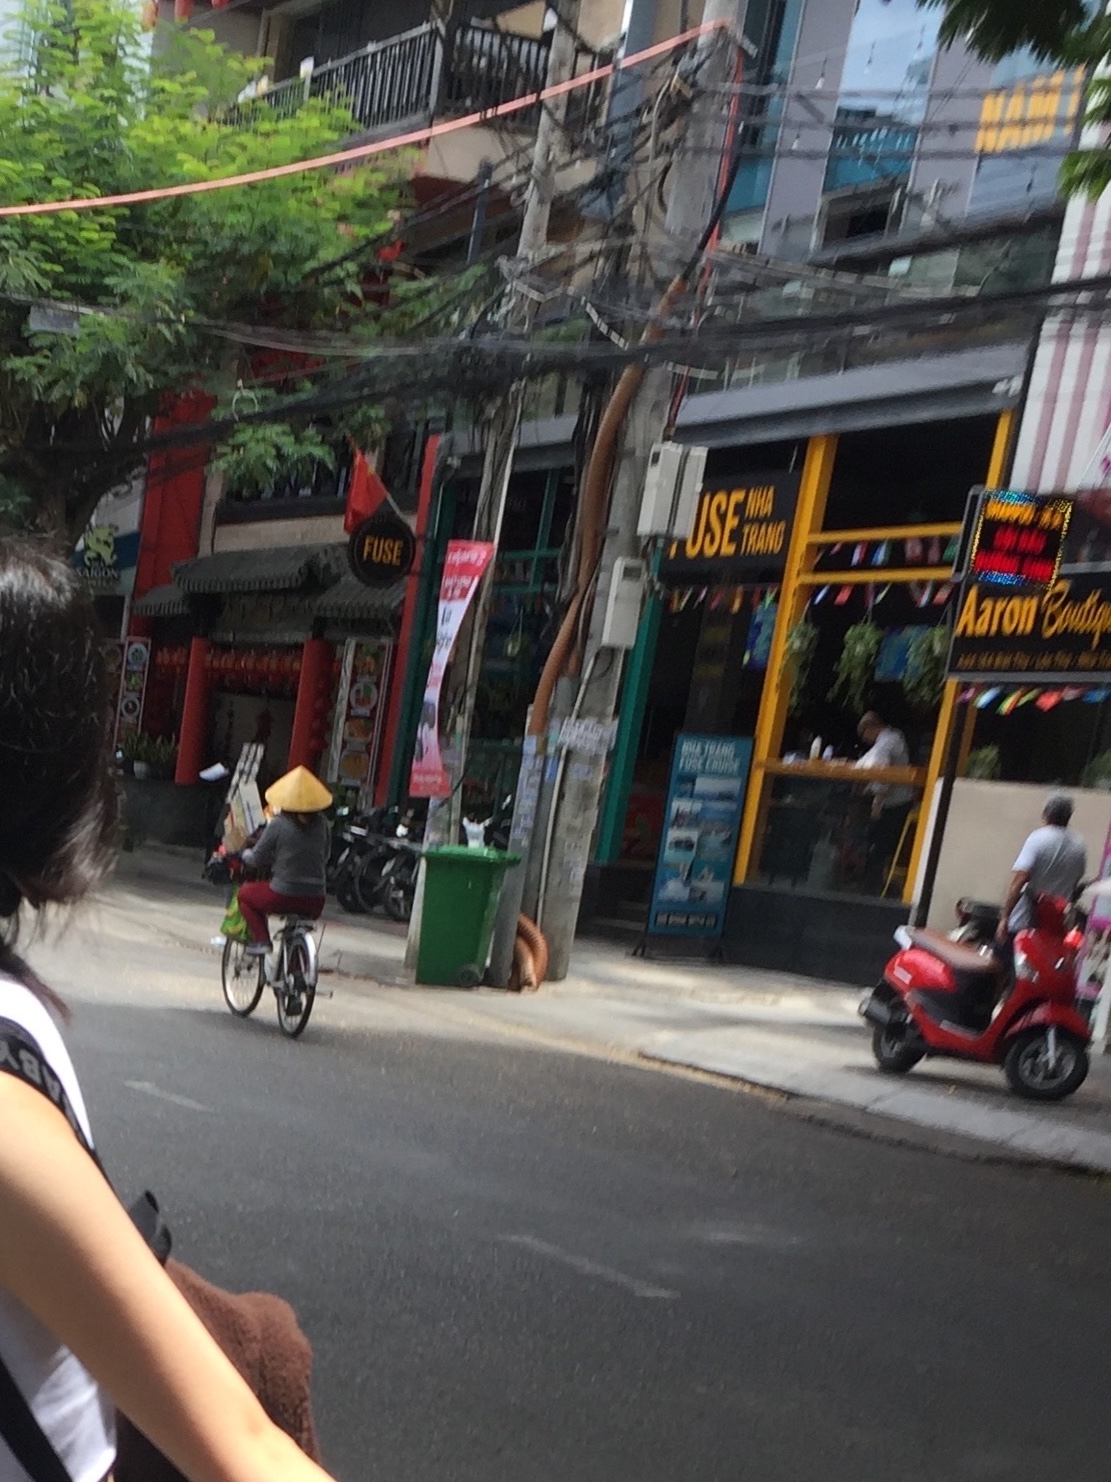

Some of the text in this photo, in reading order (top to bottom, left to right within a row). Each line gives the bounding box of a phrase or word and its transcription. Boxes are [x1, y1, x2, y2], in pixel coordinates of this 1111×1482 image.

[744, 485, 775, 519] NHA
[669, 486, 746, 560] USE
[740, 520, 787, 556] TRANG
[363, 534, 404, 568] FUSE
[954, 580, 1039, 639] Aaron
